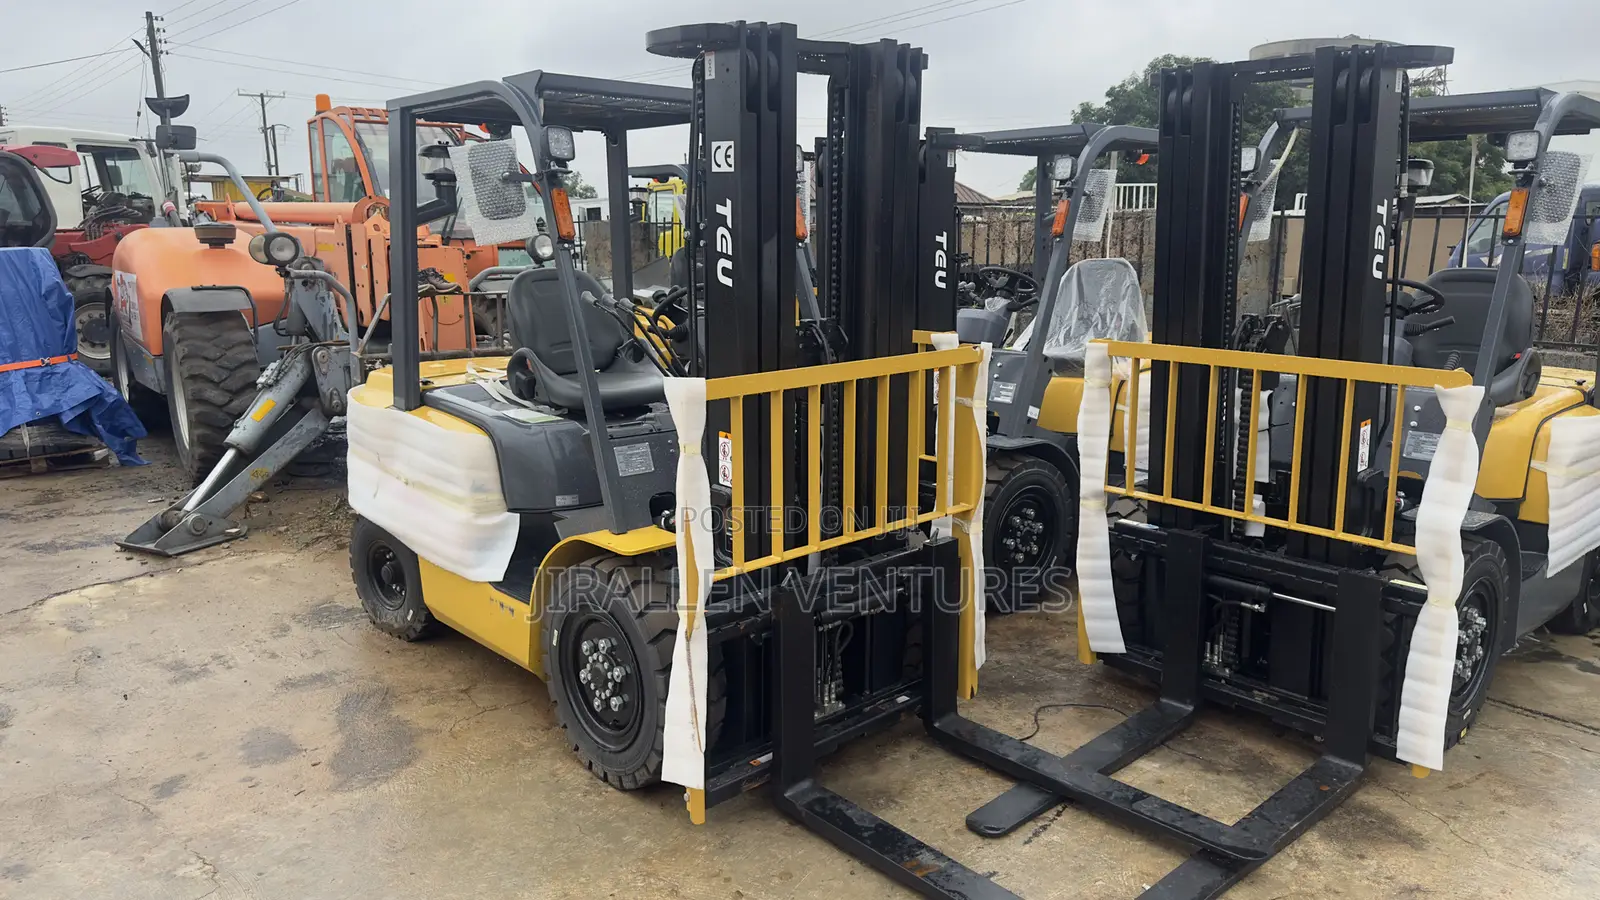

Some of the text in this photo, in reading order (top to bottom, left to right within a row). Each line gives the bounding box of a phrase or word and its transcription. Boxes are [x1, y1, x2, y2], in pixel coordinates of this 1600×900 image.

[714, 145, 732, 168] CE
[715, 198, 733, 288] TEU
[935, 231, 947, 289] TEU
[1372, 198, 1388, 280] TEU
